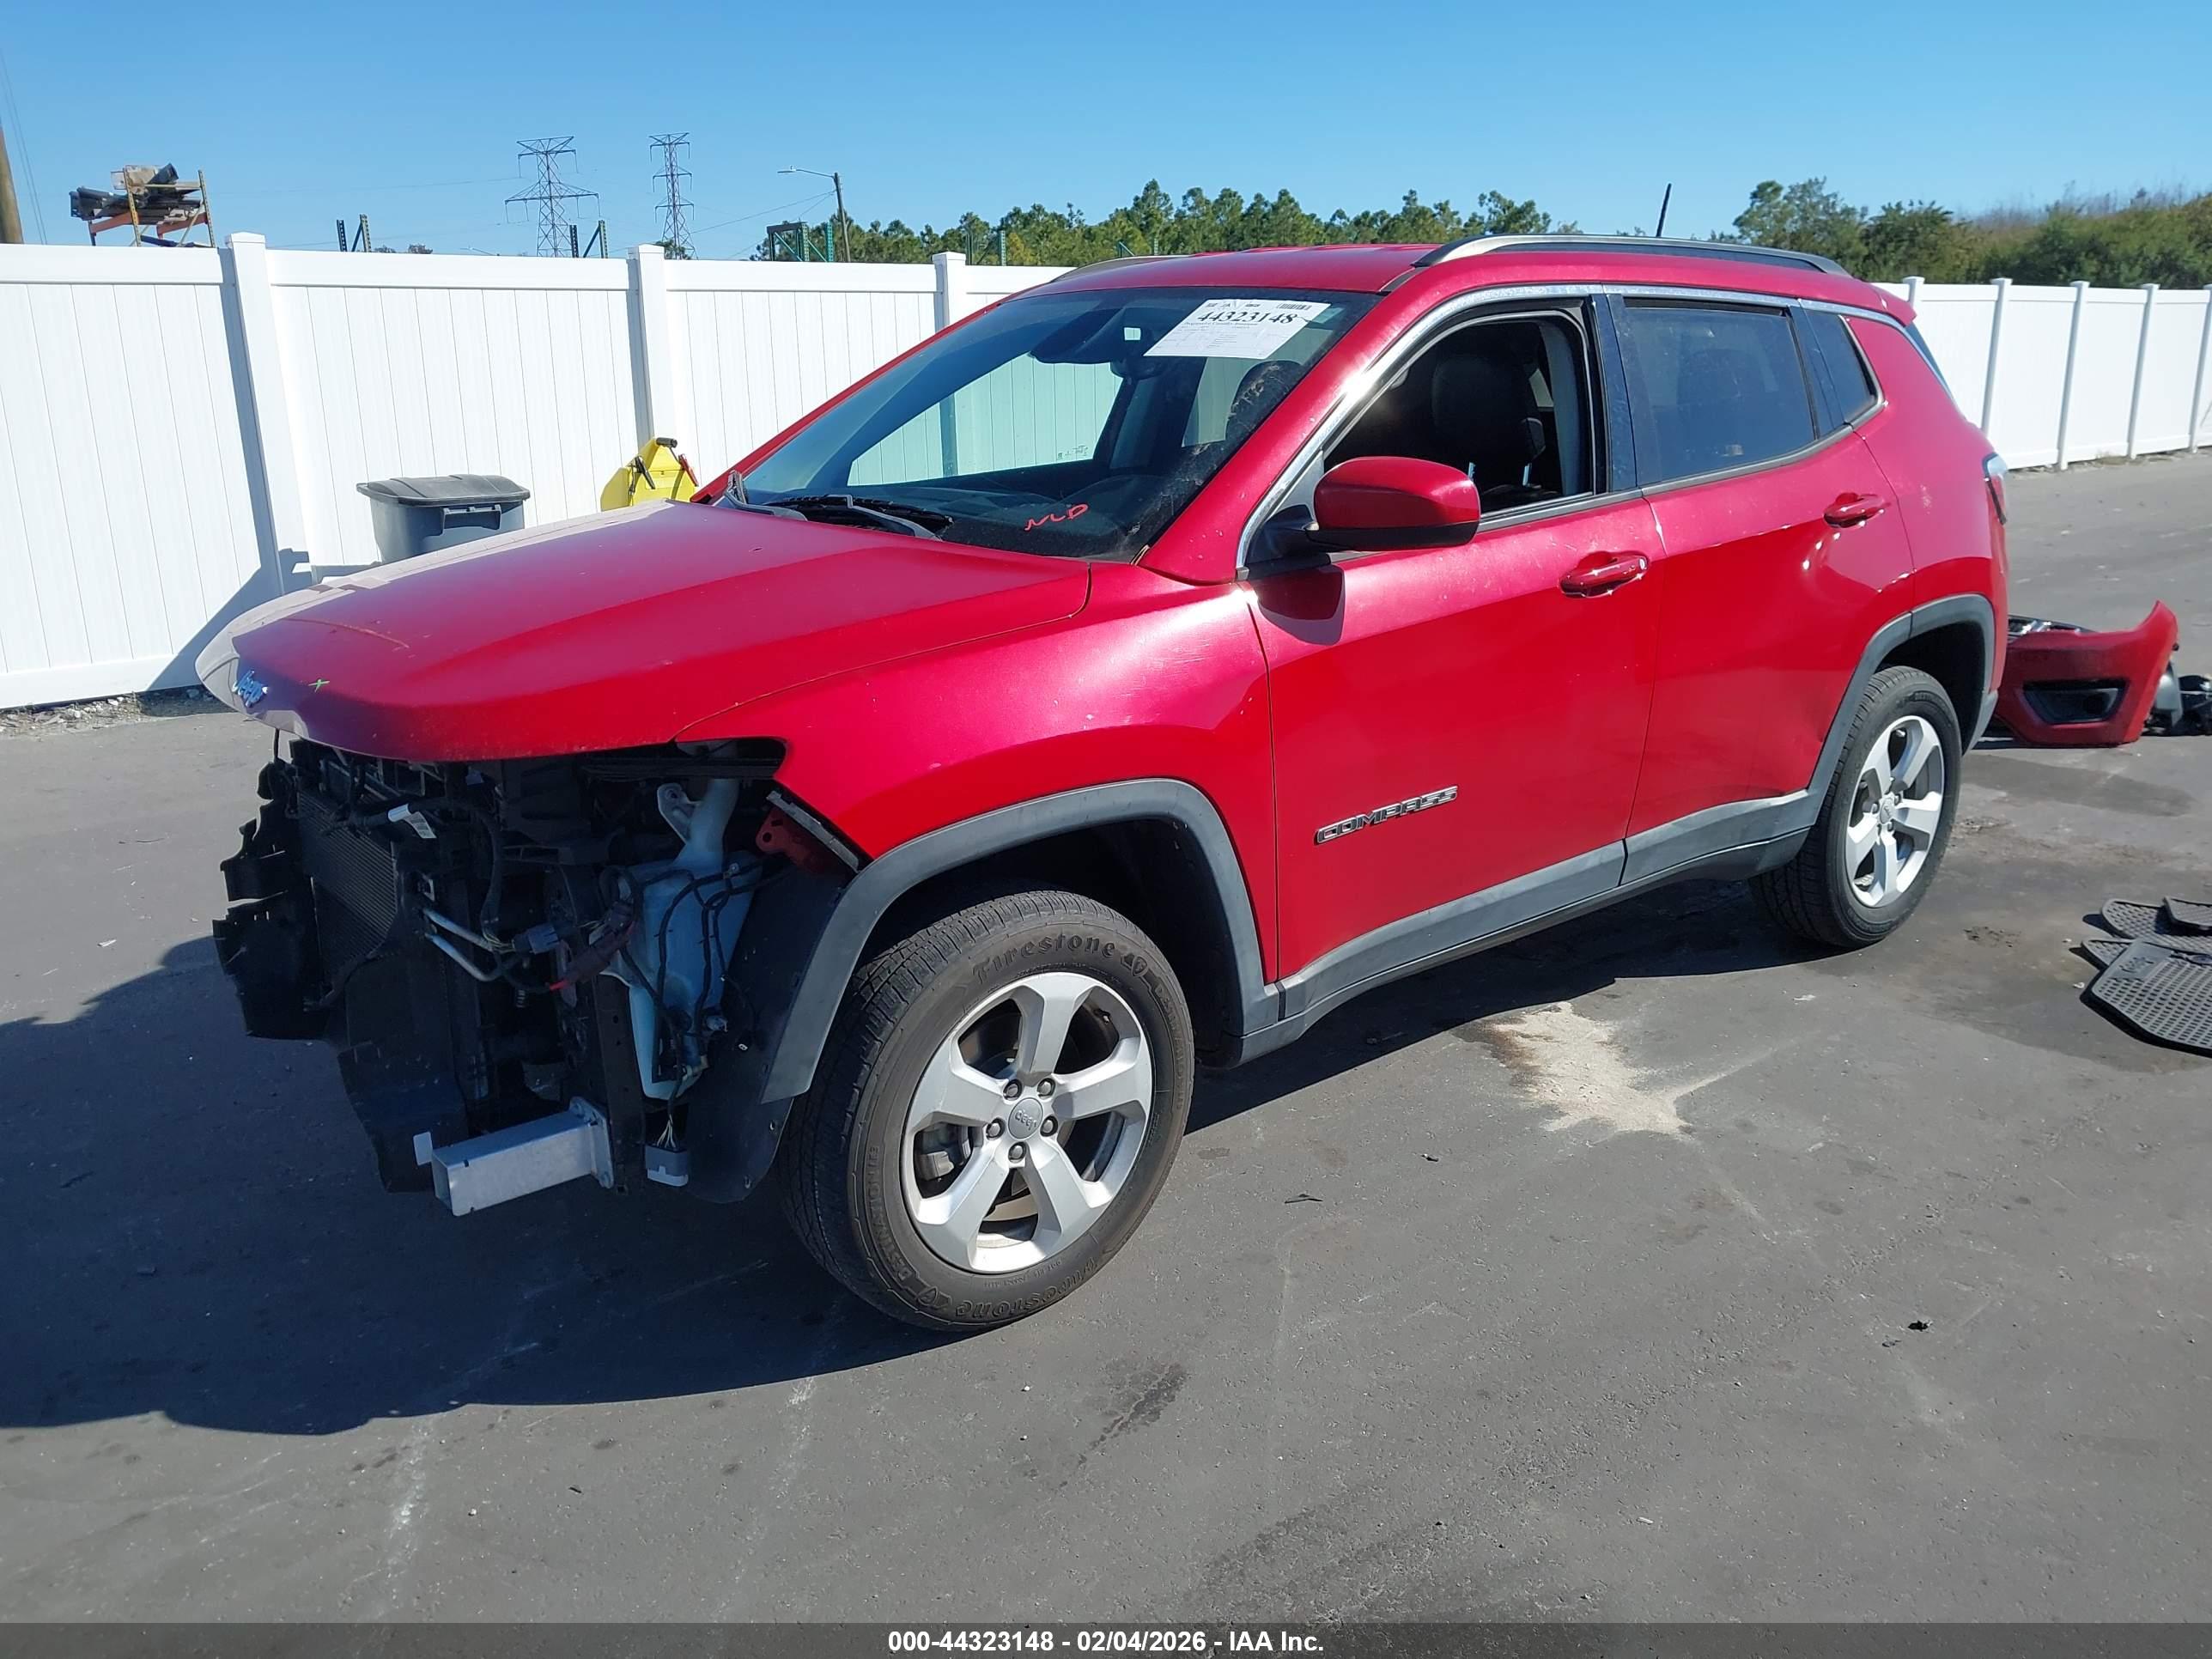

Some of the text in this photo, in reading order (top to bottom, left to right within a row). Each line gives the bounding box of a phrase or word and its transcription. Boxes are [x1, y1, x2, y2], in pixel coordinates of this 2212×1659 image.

[1197, 310, 1298, 325] 44323148
[1316, 785, 1459, 844] COMPASS
[972, 933, 1115, 984] Firestone
